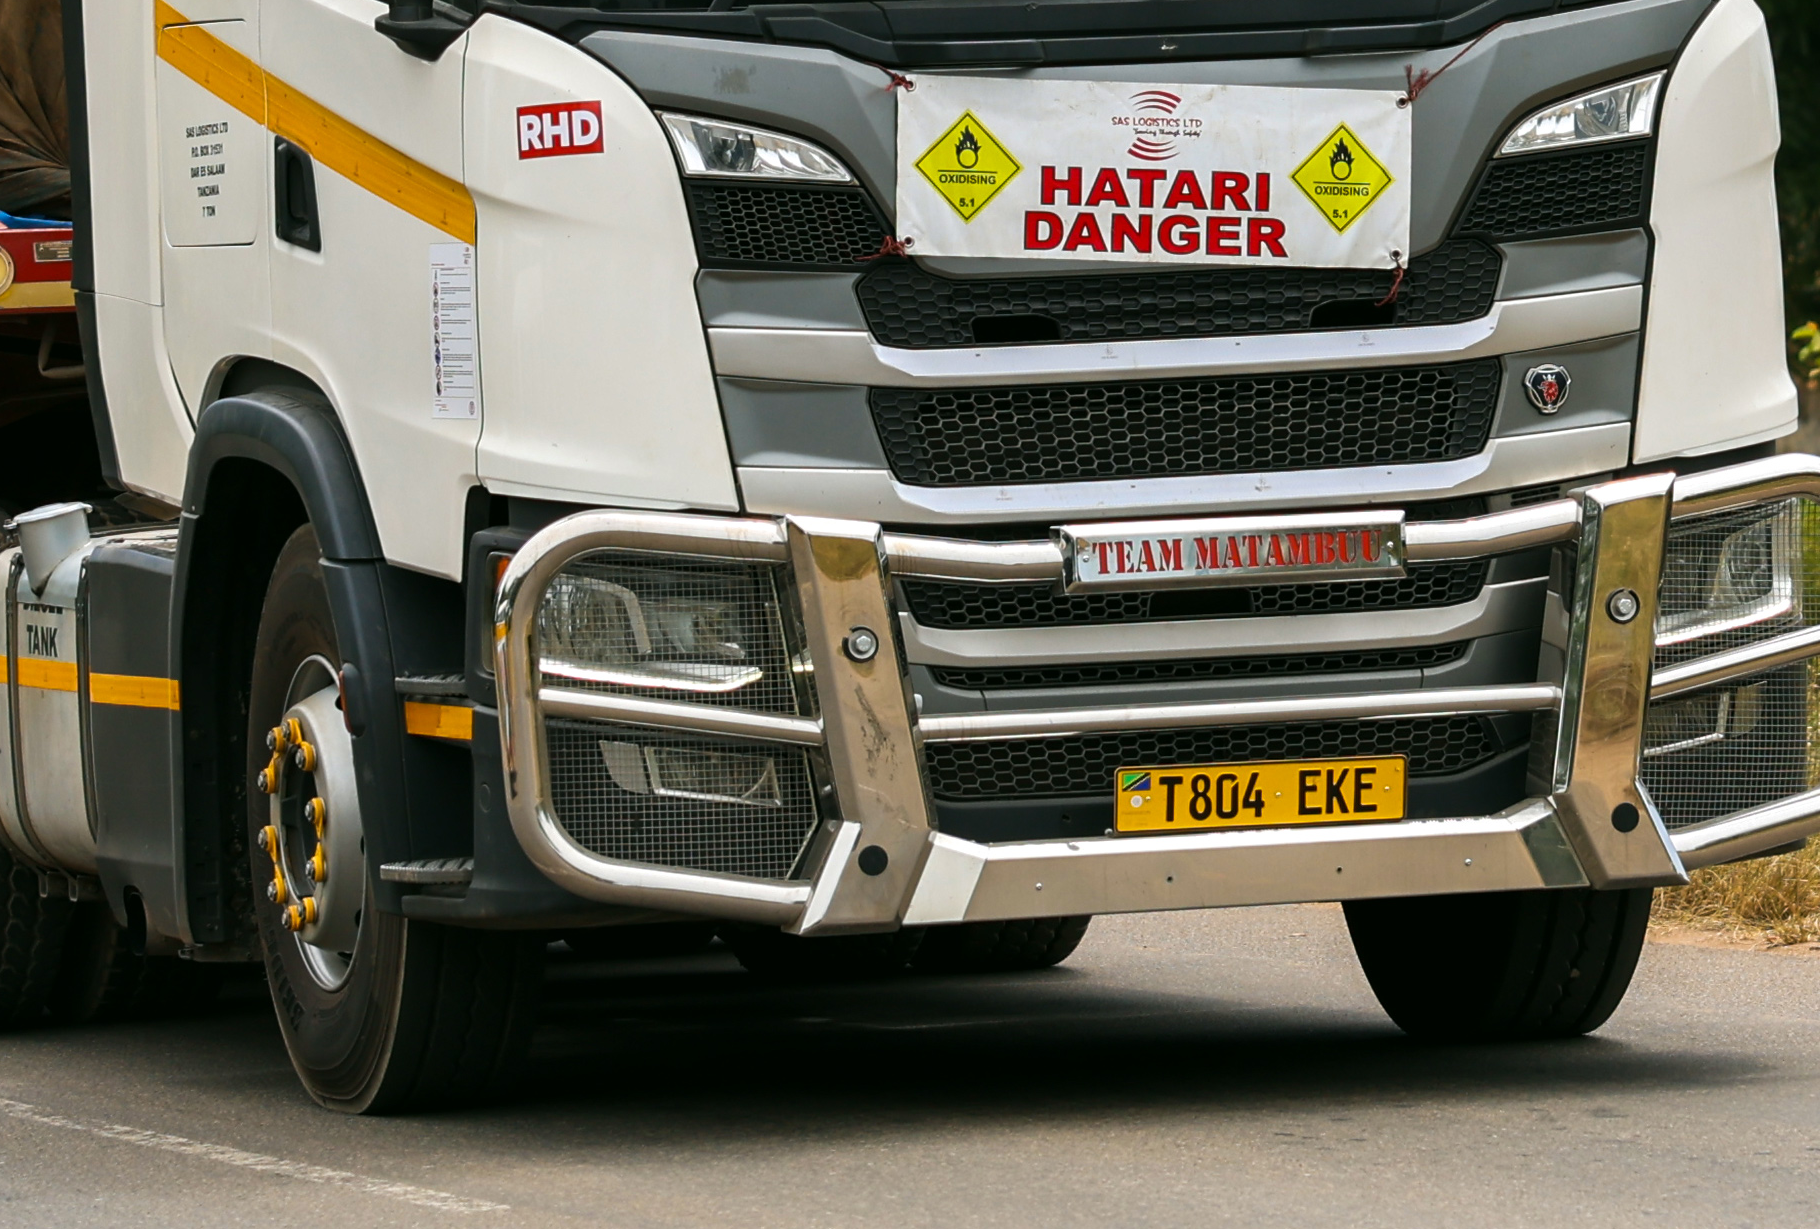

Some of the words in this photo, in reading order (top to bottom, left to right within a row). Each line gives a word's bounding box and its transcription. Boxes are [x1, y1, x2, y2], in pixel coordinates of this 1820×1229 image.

[519, 109, 600, 151] RHD
[1111, 116, 1130, 126] SAS
[1133, 117, 1180, 128] LOGISTICS
[1183, 118, 1203, 128] LTD
[938, 173, 997, 185] OXIDISING
[1040, 165, 1271, 212] HATARI
[1314, 185, 1370, 197] OXIDISING
[959, 197, 976, 208] 5.1
[1332, 208, 1348, 219] 5.1
[1023, 210, 1289, 258] DANGER
[1092, 538, 1184, 575] TEAM
[1194, 529, 1382, 570] MATAMBUU
[26, 624, 59, 658] TANK
[1158, 771, 1266, 823] T804
[1297, 766, 1378, 816] EKE
